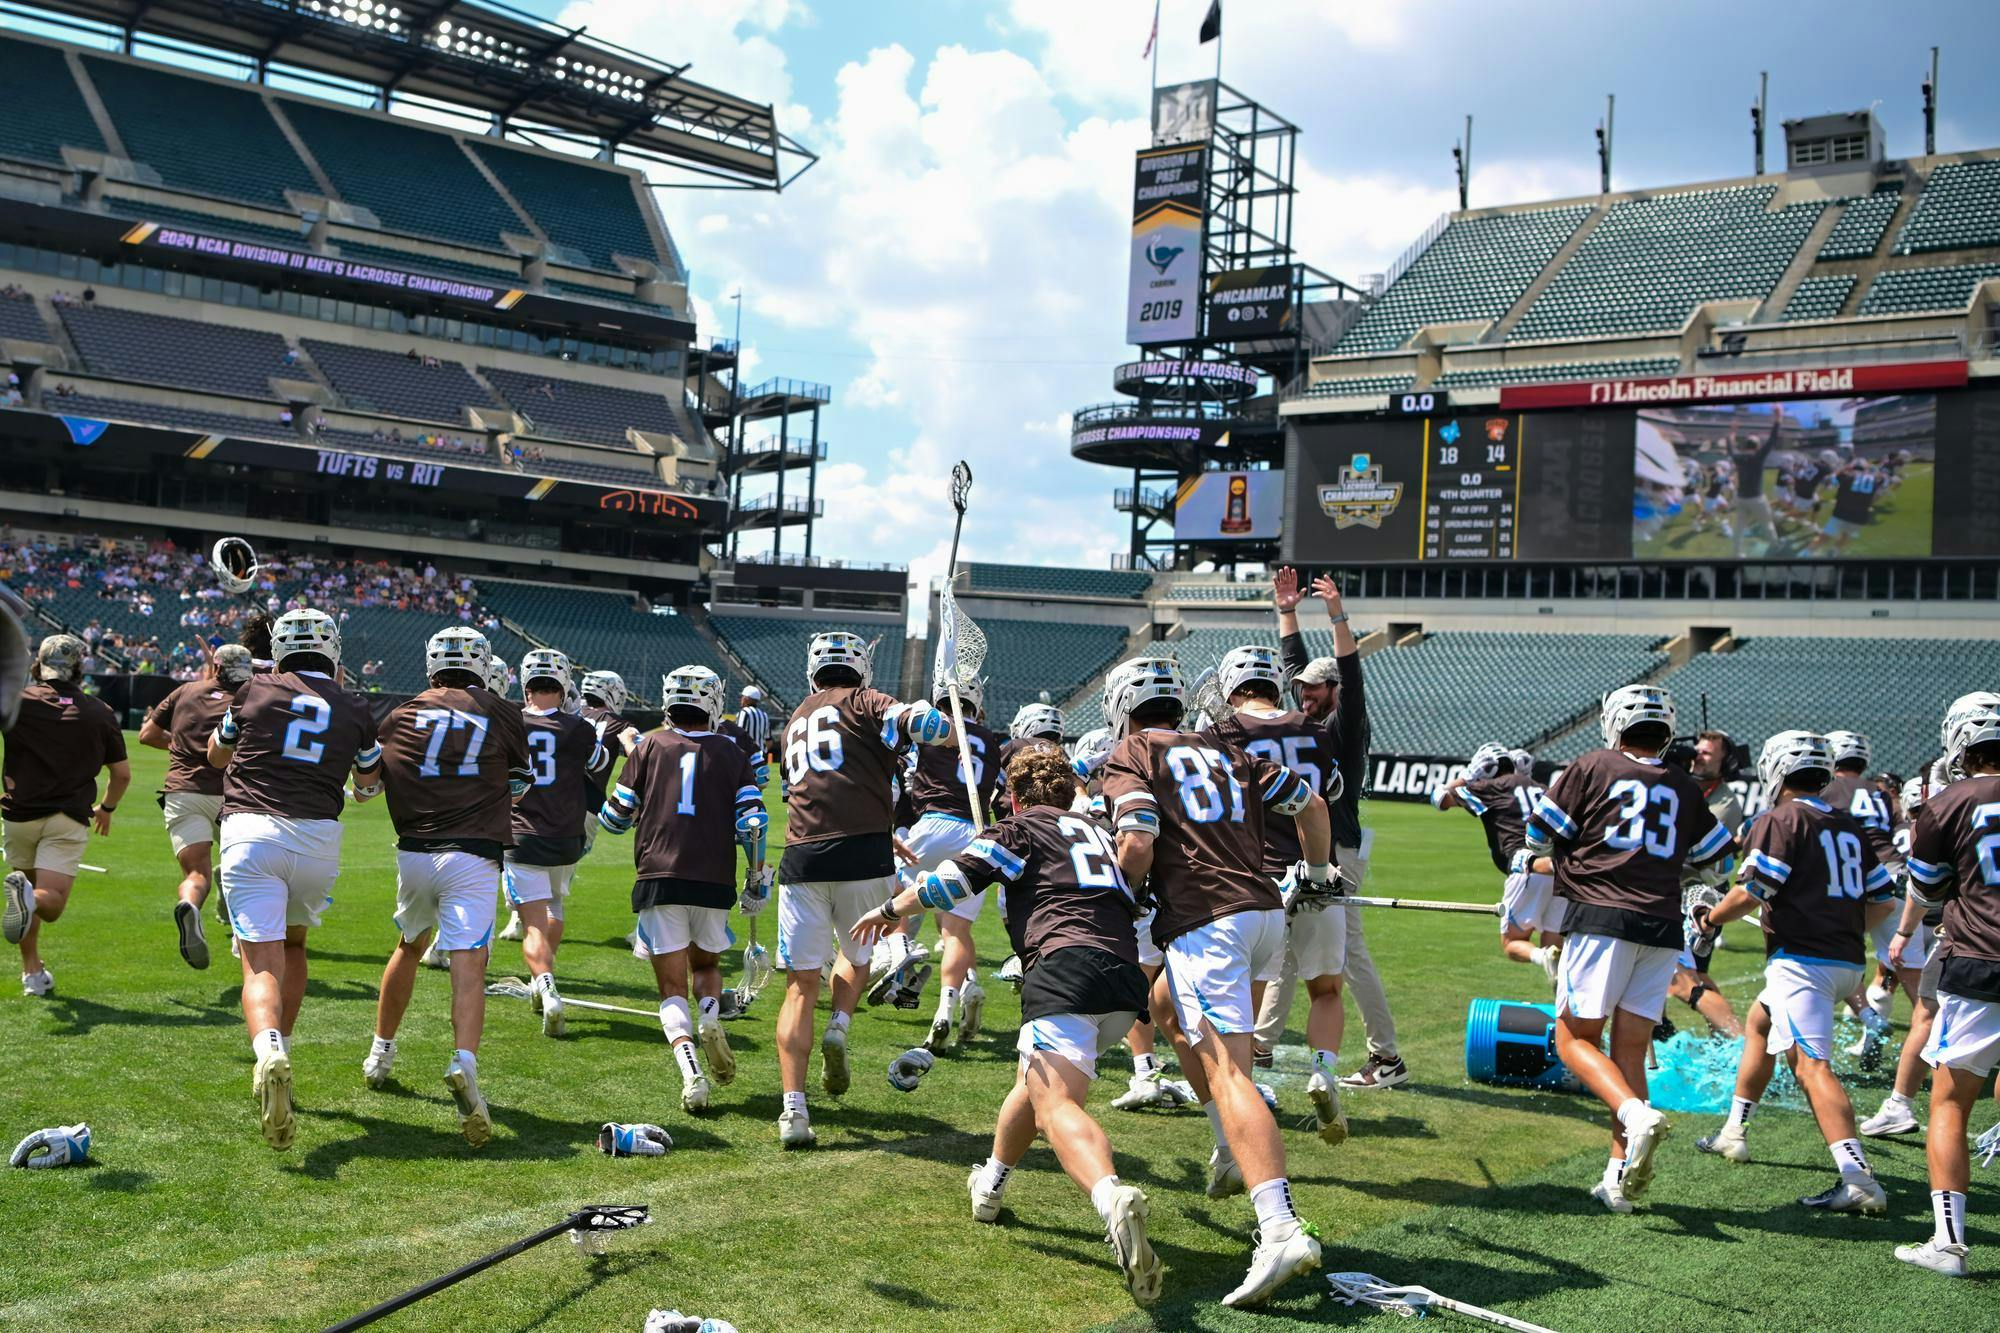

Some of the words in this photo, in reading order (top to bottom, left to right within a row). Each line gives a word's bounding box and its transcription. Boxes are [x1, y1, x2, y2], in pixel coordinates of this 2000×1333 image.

[1141, 154, 1186, 172] DIVISION
[1187, 151, 1199, 164] III
[1155, 169, 1182, 184] PAST
[1138, 181, 1199, 200] CHAMPIONS
[158, 229, 195, 250] 2024
[196, 236, 230, 256] NCAA
[232, 243, 288, 266] DIVISION
[289, 253, 304, 269] III
[305, 257, 345, 277] MEN'S
[346, 263, 406, 287] LACROSSE
[407, 274, 494, 302] CHAMPIONSHIP
[1213, 284, 1288, 305] #NCAAMLAX
[1140, 299, 1182, 322] 2019
[1126, 361, 1181, 380] ULTIMATE
[1183, 361, 1244, 381] LACROSSE
[1614, 378, 1691, 402] Lincoln
[1694, 373, 1793, 398] Financial
[1796, 368, 1854, 393] Field
[1402, 394, 1434, 412] 0.0
[1107, 425, 1201, 441] CHAMPIONSHIPS
[1440, 447, 1458, 465] 18
[1486, 445, 1505, 463] 14
[316, 451, 379, 479] TUFTS
[410, 462, 446, 487] RIT
[1460, 473, 1482, 485] 0.0
[1440, 490, 1458, 499] 4TH
[1459, 488, 1502, 500] QUARTER
[281, 693, 332, 765] 2
[927, 715, 937, 735] STX
[414, 708, 490, 777] 77
[784, 704, 846, 785] 66
[676, 751, 697, 816] 1
[1164, 745, 1247, 824] 87
[1603, 779, 1680, 860] 33
[1850, 787, 1892, 833] 41
[1818, 829, 1866, 900] 18
